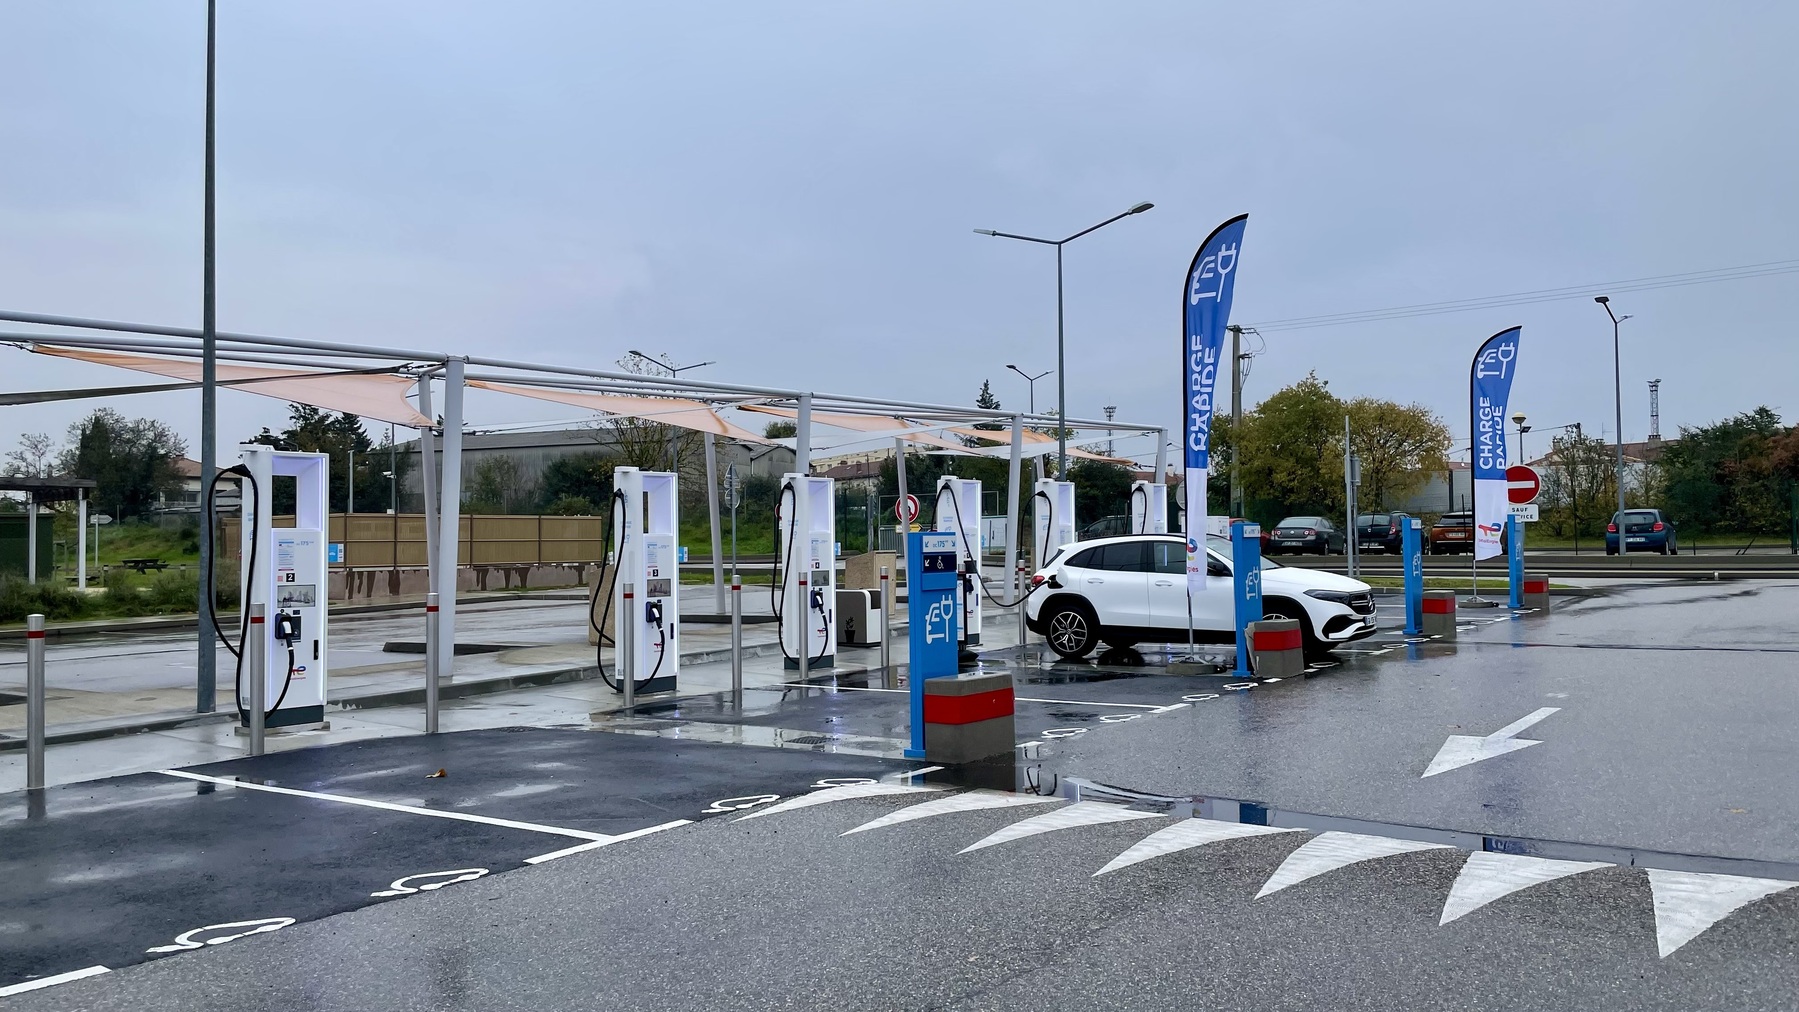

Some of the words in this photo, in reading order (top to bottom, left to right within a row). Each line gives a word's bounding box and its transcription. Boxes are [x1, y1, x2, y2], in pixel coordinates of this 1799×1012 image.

[1189, 334, 1204, 451] CHARGE
[1479, 396, 1493, 470] CHARGE
[287, 573, 293, 581] 2
